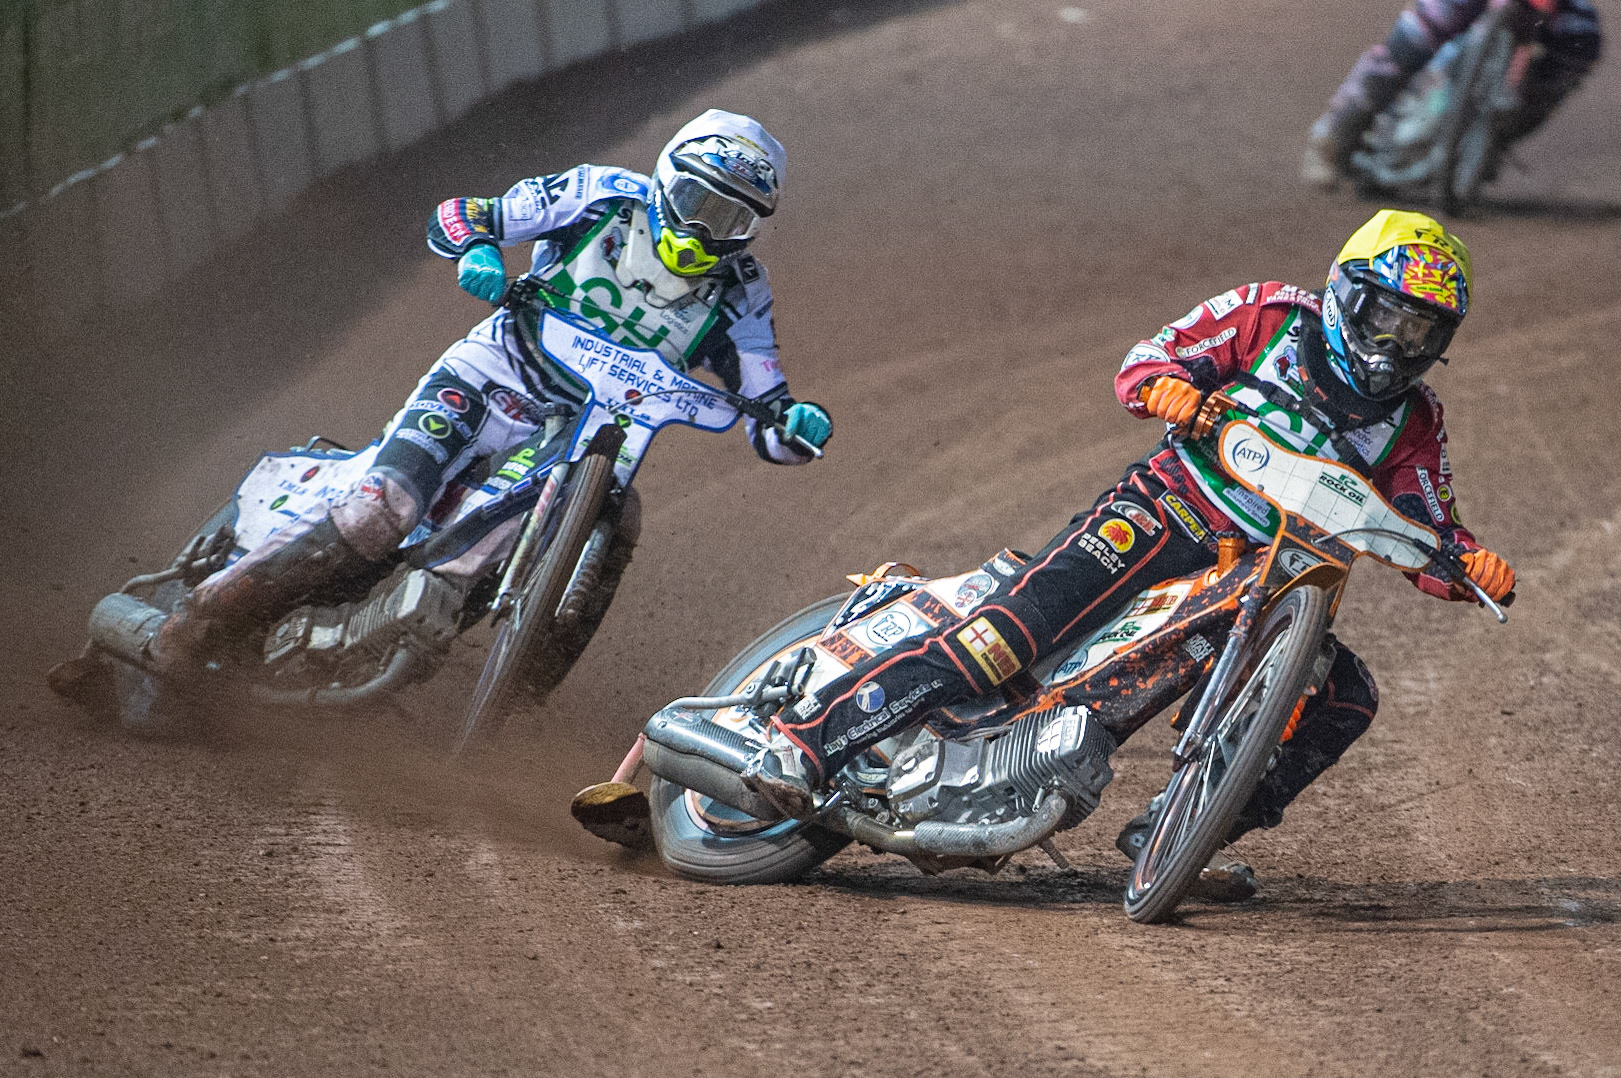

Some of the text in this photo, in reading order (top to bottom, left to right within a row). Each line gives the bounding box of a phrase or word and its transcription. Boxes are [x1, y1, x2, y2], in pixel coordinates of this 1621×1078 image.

[1186, 328, 1235, 356] FORCEFIELD
[571, 335, 717, 410] INDUSTRIAL & MARINE
[578, 354, 699, 417] LIFT SERVICES LTD
[1236, 446, 1266, 465] ATPI
[1319, 474, 1366, 505] ROCK OIL
[1418, 466, 1443, 521] FORCEFIELD
[1077, 539, 1119, 575] BEACH
[1083, 532, 1126, 569] PEBLEY
[1057, 660, 1082, 676] ATPI
[846, 708, 892, 740] Electrical
